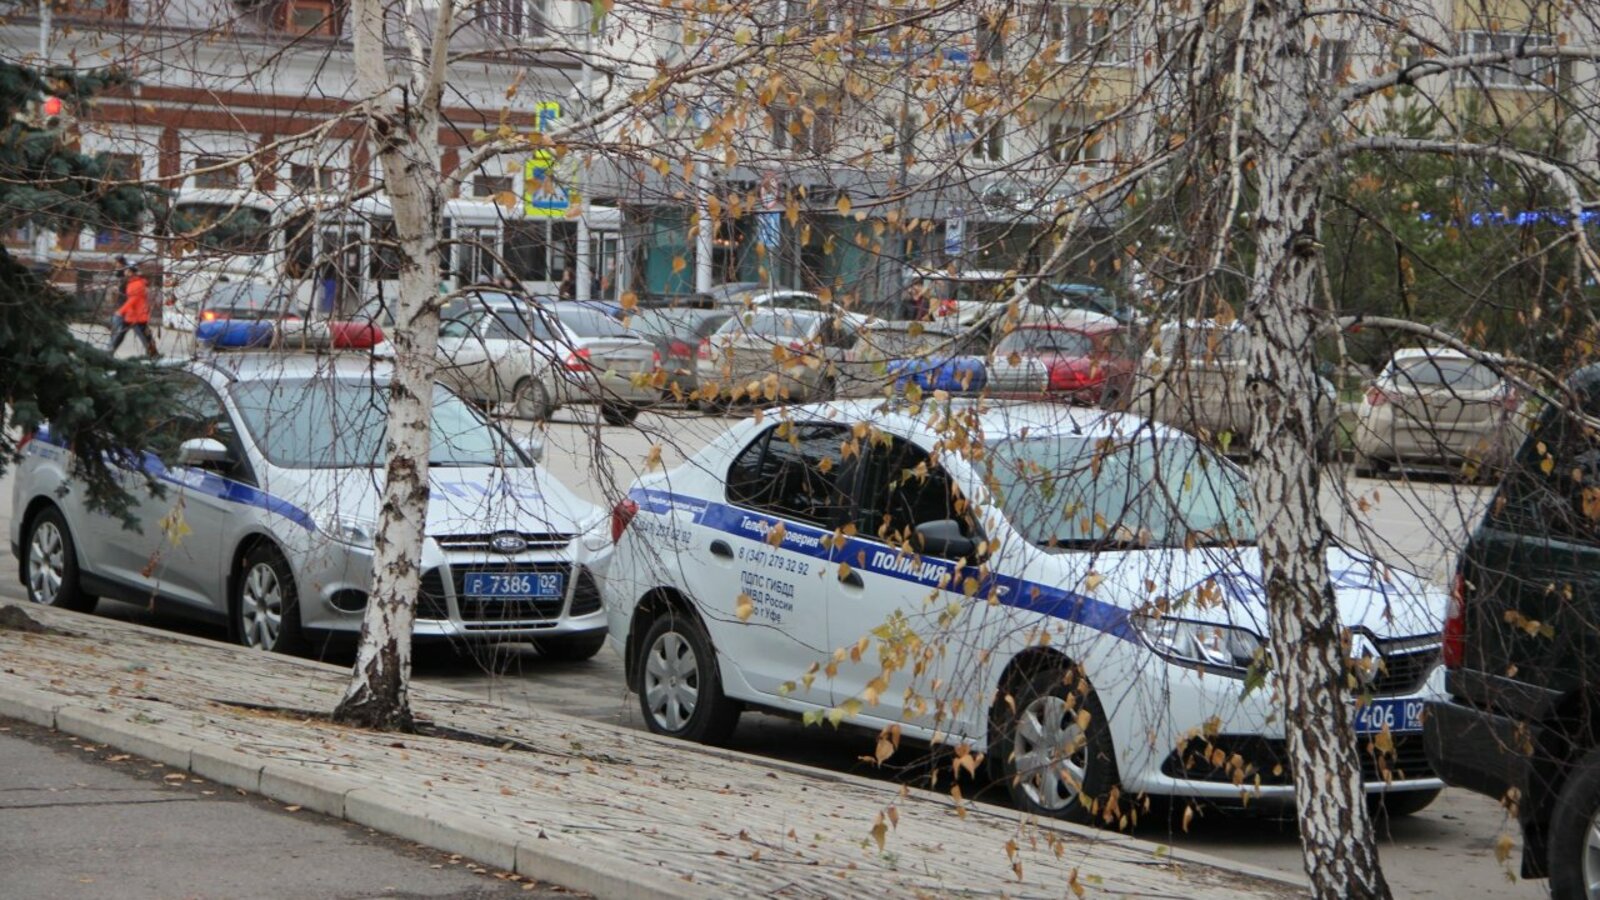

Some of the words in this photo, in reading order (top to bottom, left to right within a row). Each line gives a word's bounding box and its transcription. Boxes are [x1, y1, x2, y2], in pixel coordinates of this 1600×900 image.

[782, 528, 820, 548] оверия
[738, 547, 745, 559] 8
[746, 549, 767, 568] (347)
[768, 554, 785, 569] 279
[785, 559, 796, 573] 32
[798, 562, 810, 576] 92
[872, 551, 947, 581] ПОЛИЦИЯ
[490, 576, 531, 593] 7386
[540, 575, 557, 588] 02
[765, 577, 795, 600] ГИБДД
[765, 593, 794, 612] России
[765, 607, 782, 625] Уфе
[1355, 705, 1395, 728] 406
[1407, 702, 1424, 720] 02
